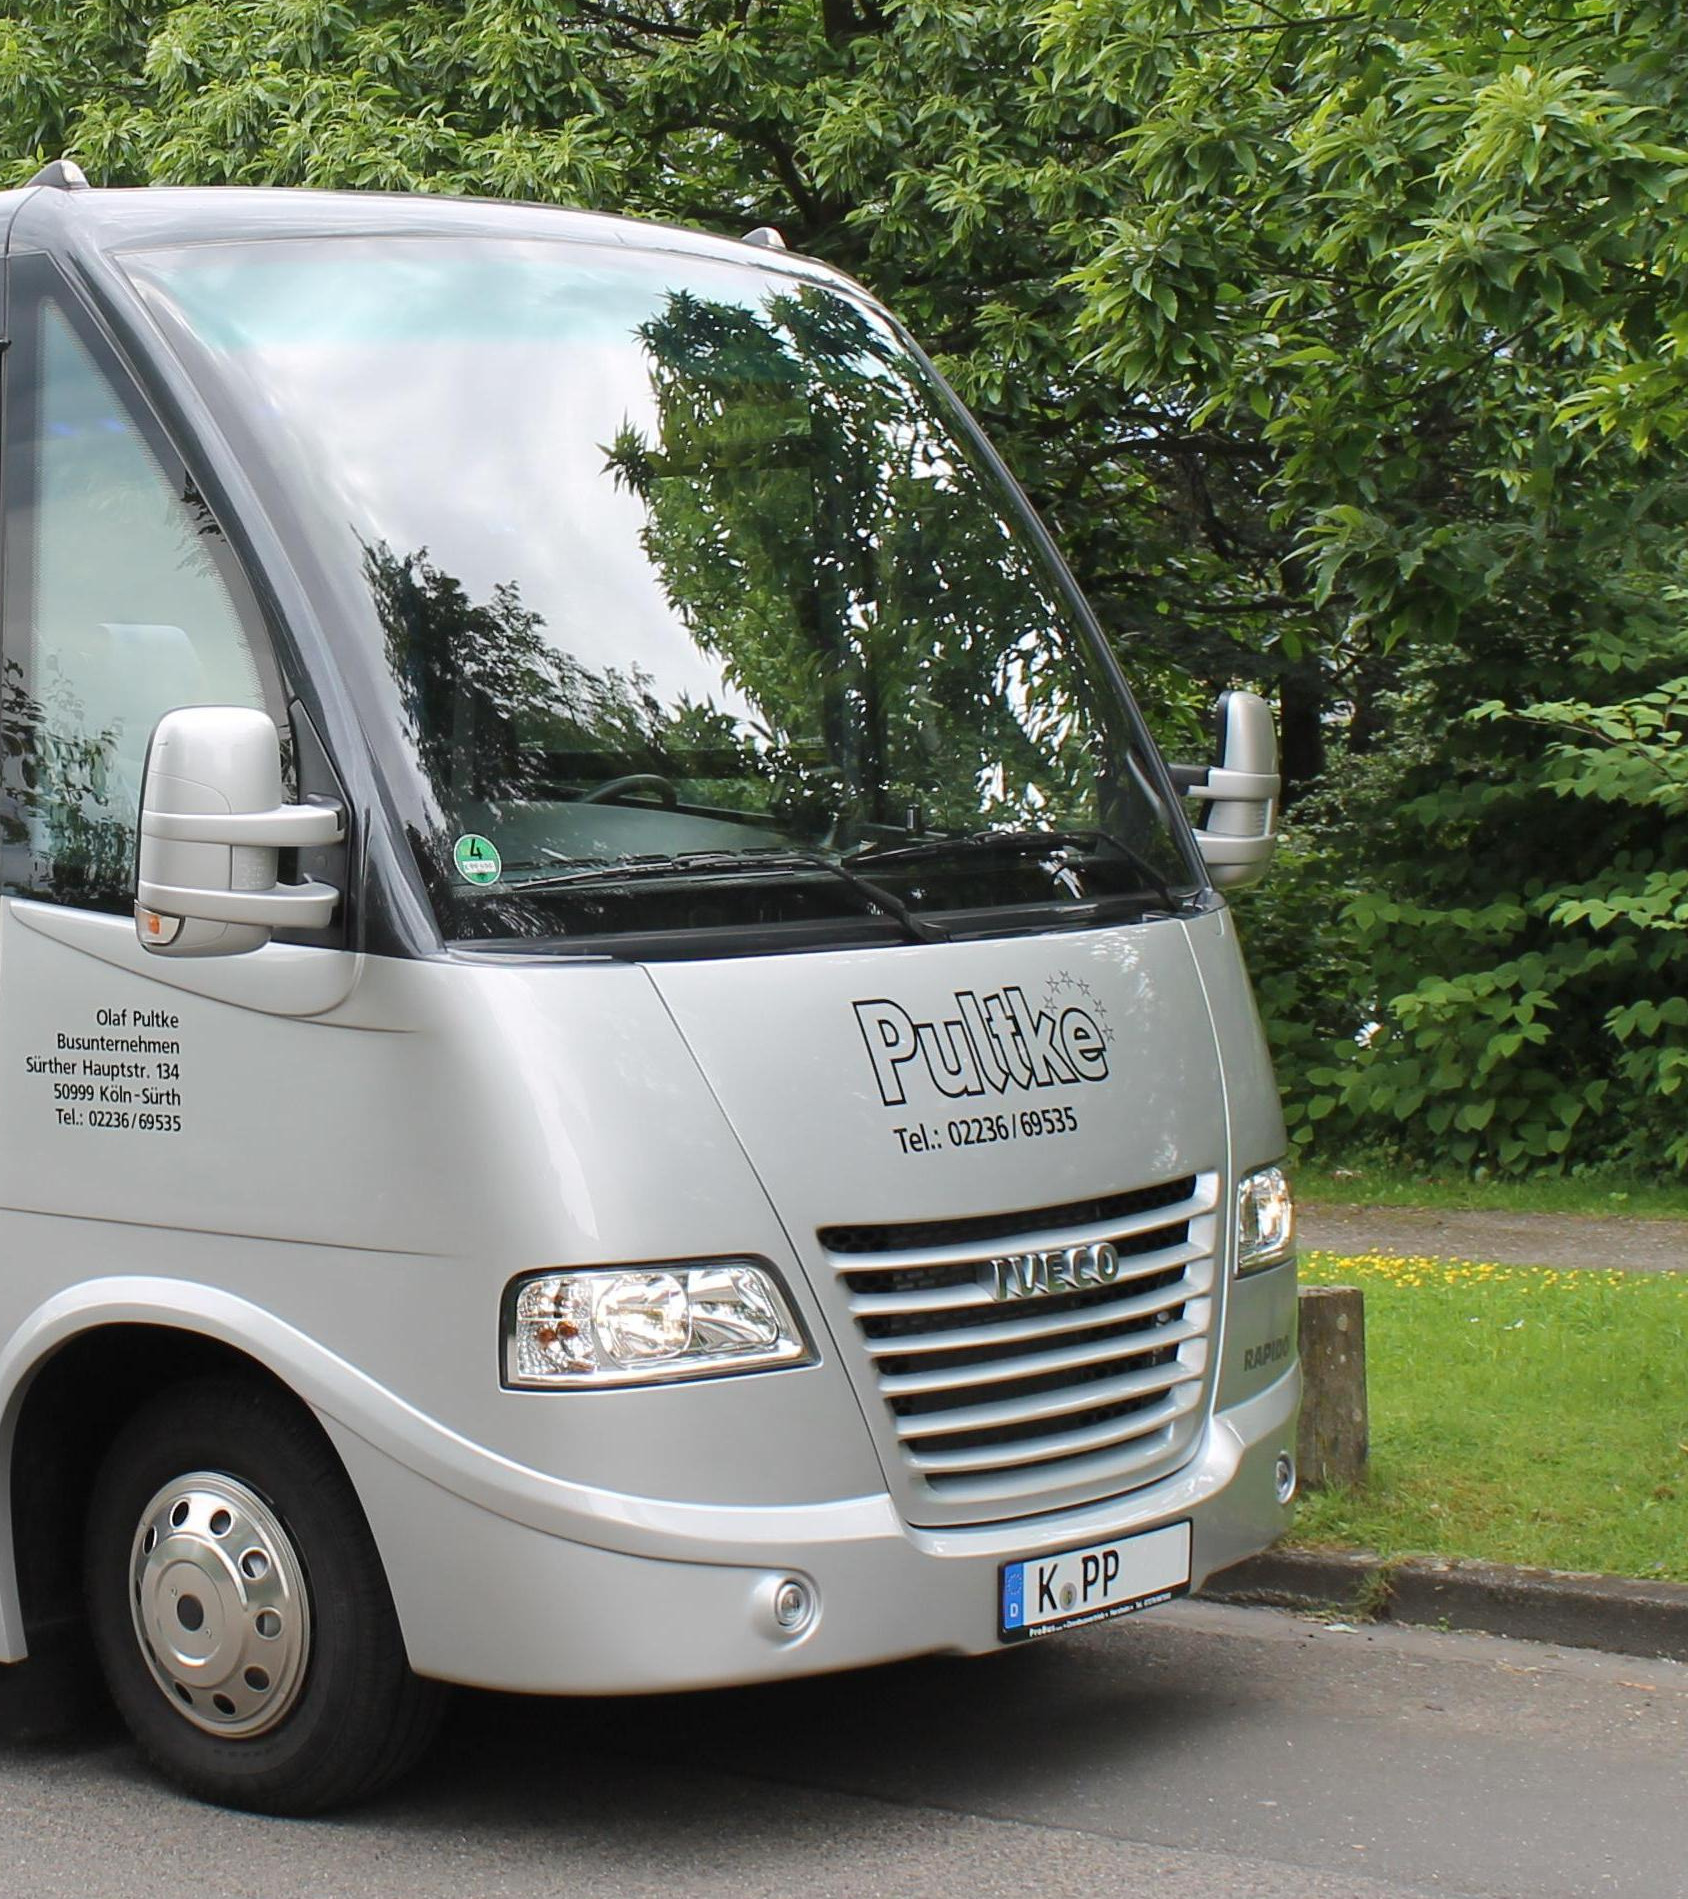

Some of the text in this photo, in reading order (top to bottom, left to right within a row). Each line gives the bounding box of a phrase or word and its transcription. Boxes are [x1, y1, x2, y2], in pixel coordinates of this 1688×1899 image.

[470, 838, 483, 860] 4
[96, 1008, 179, 1028] Olaf Pultke
[57, 1033, 180, 1054] Busunternehmen
[851, 985, 1109, 1107] Pultke
[26, 1055, 180, 1081] Sürther Hauptstr. 134
[54, 1083, 94, 1101] 50999
[55, 1108, 182, 1132] Tel.: 02236/69535
[893, 1123, 942, 1154] Tel.:
[991, 1242, 1119, 1301] IVECO
[1243, 1334, 1289, 1372] RAPIDO
[1038, 1550, 1120, 1613] K PP
[1010, 1602, 1019, 1618] D
